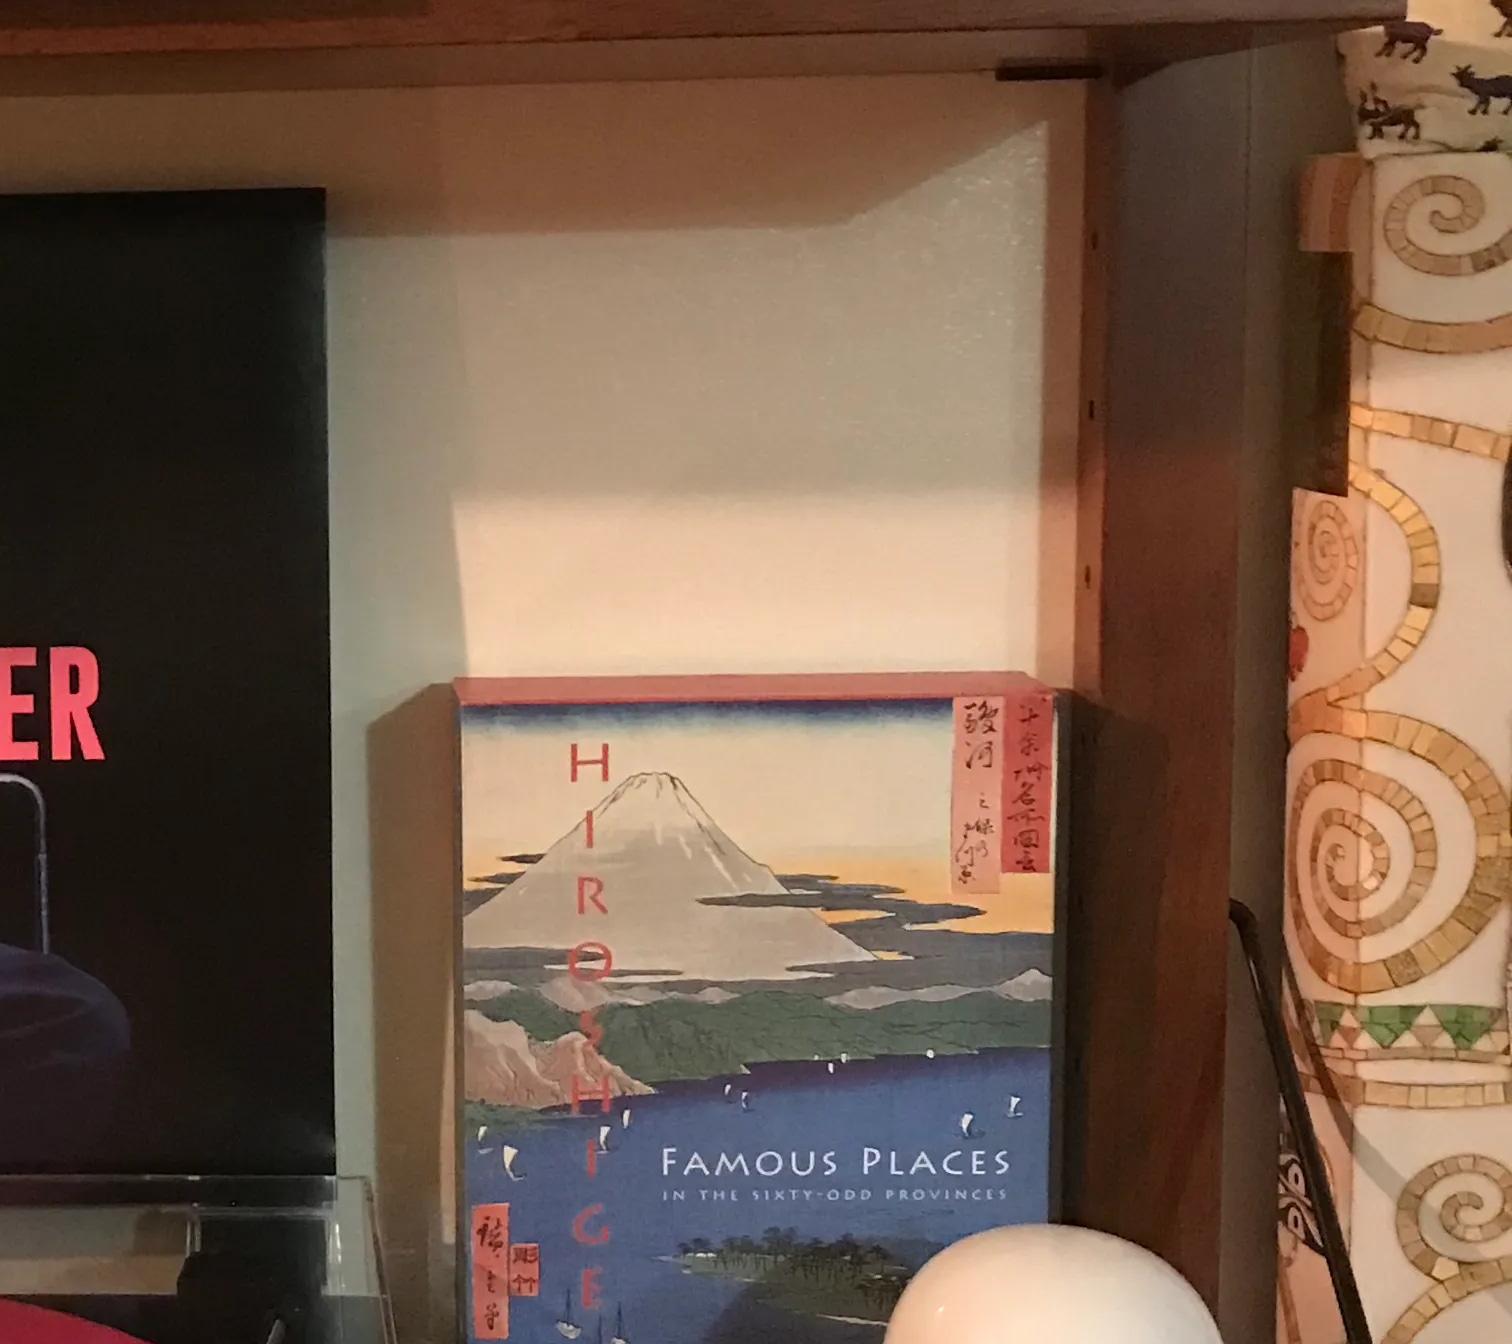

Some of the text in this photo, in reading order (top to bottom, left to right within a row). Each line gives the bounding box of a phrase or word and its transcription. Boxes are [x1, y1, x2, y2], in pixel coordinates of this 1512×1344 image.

[570, 743, 613, 1309] HIROSHIGE
[661, 1146, 1011, 1177] FAMOUS PLACES
[662, 1188, 1007, 1201] IN THE SIXTY-ODD PROVINCES
